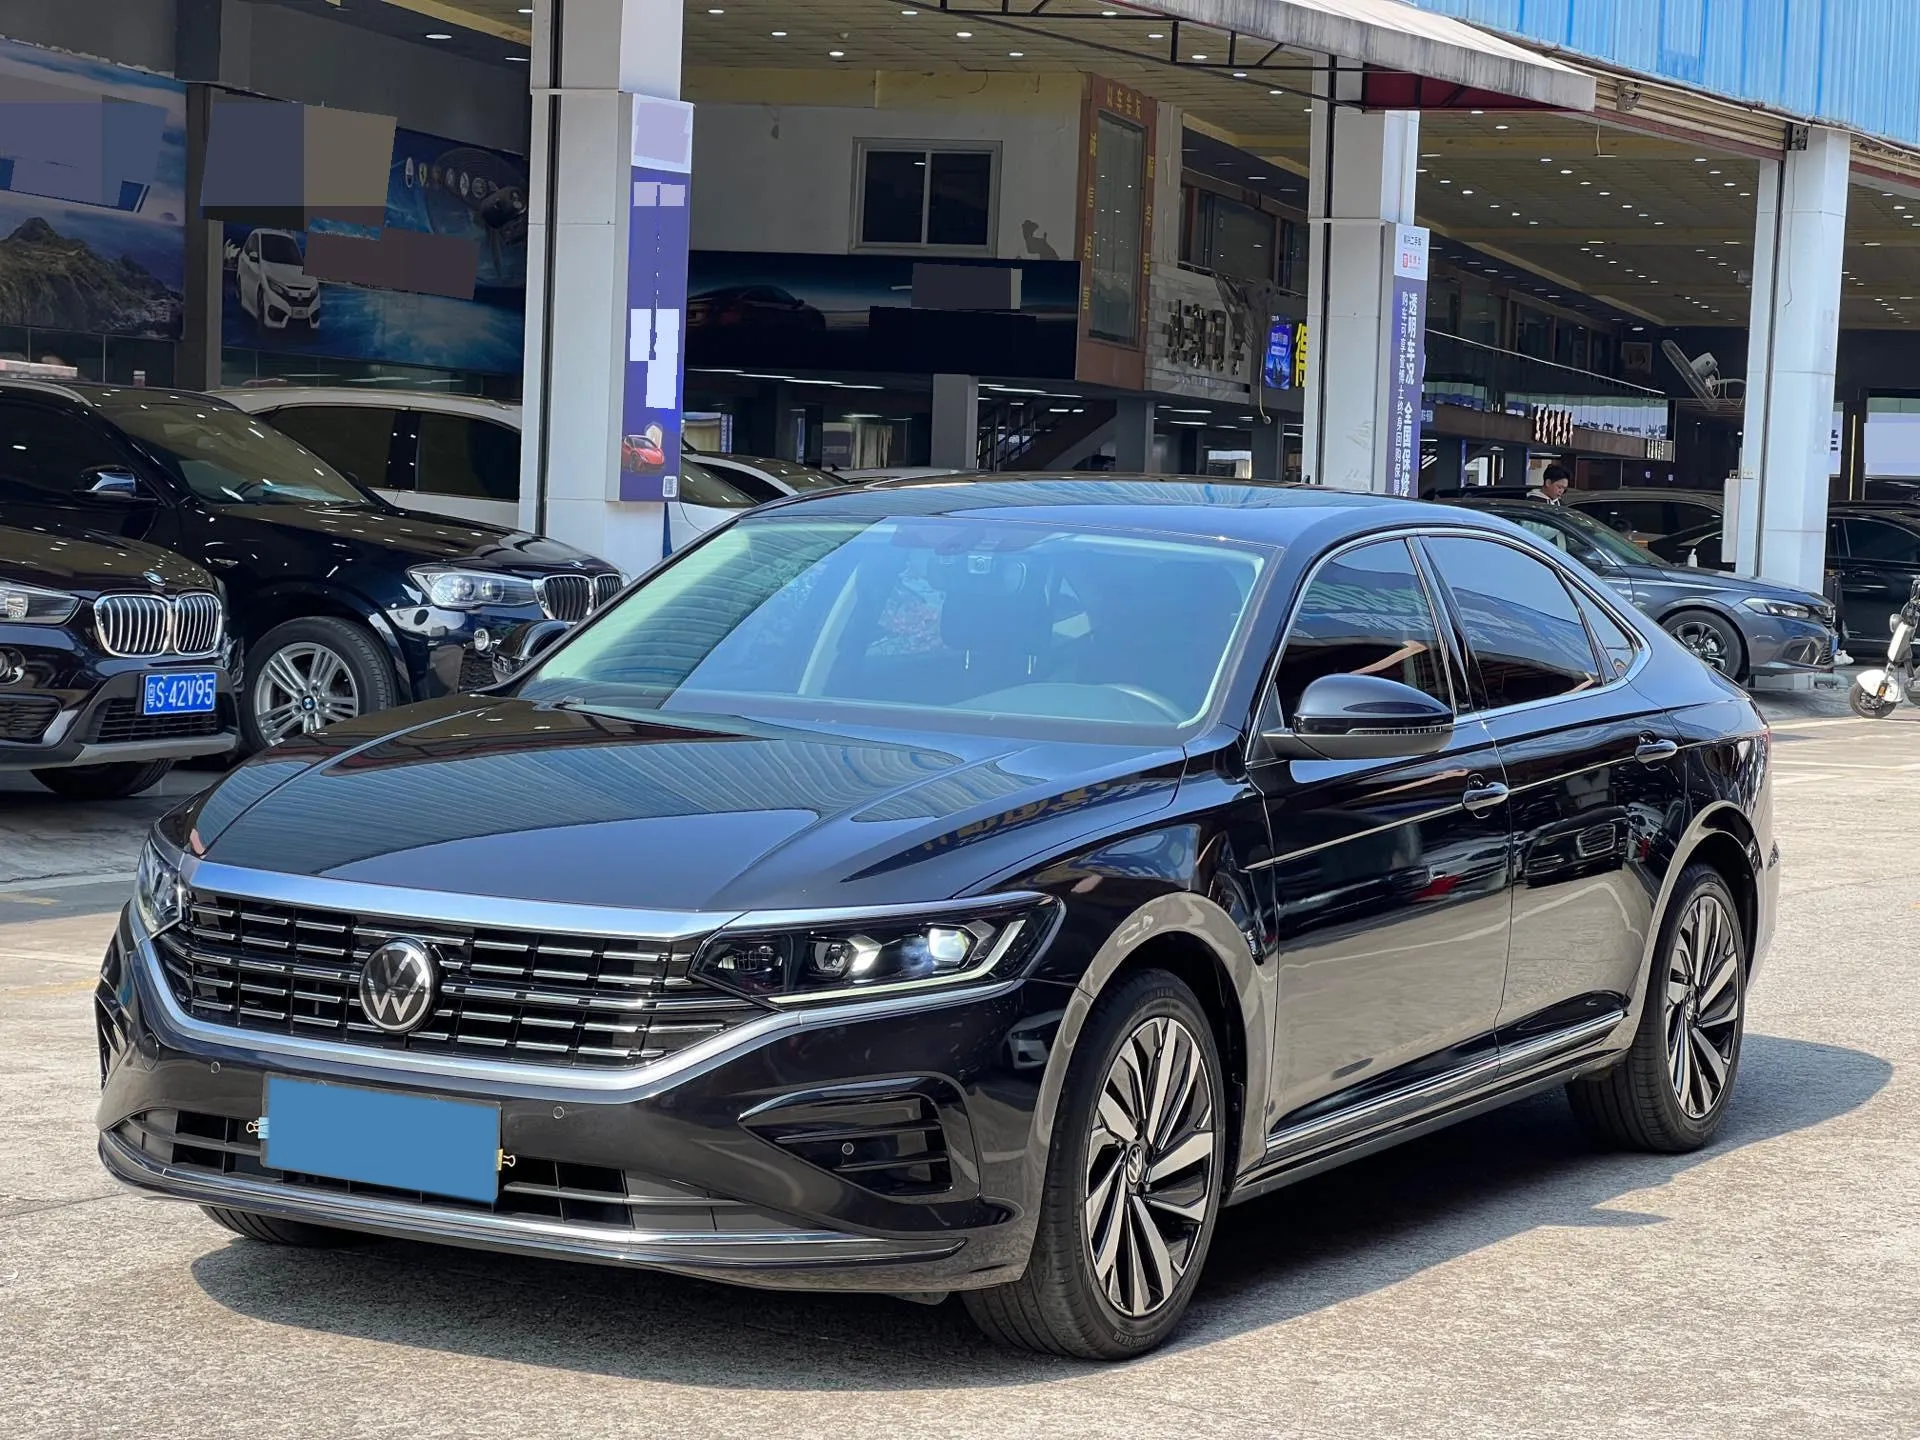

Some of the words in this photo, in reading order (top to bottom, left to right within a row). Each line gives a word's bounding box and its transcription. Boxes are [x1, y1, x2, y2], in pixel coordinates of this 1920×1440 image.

[1405, 292, 1418, 385] 透明车况
[1400, 401, 1413, 497] 全国保修
